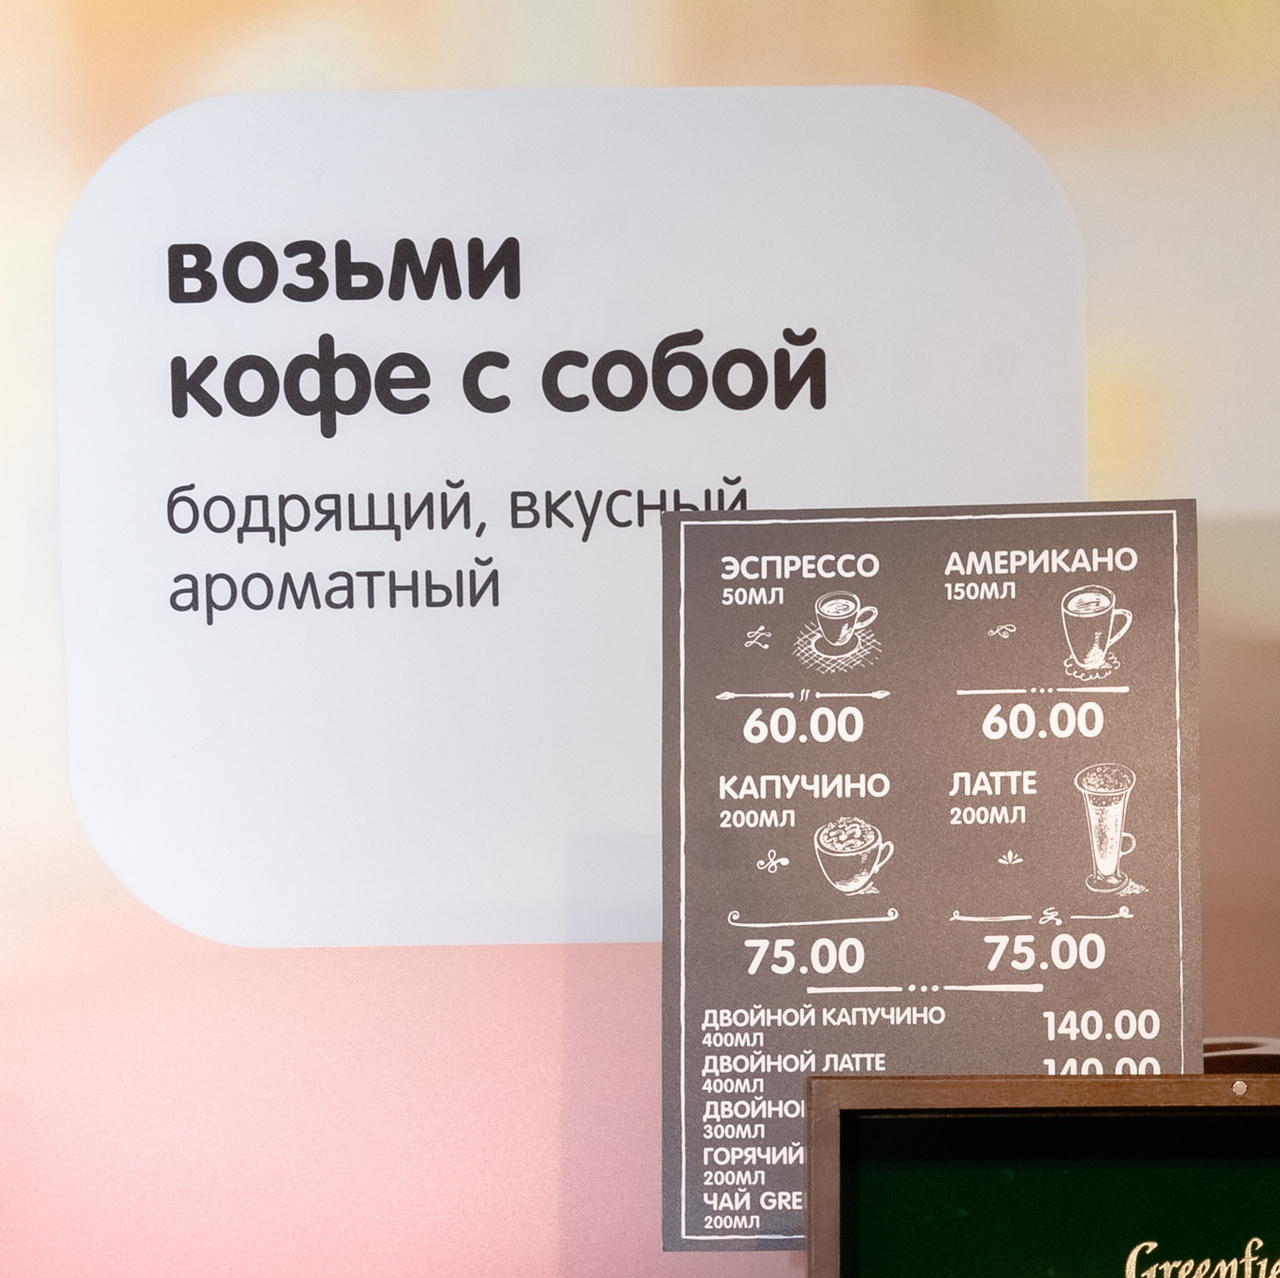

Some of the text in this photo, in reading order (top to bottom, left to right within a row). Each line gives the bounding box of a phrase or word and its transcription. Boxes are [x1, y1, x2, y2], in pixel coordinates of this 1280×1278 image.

[167, 237, 521, 304] возьми
[171, 327, 827, 439] кофе с собой
[167, 480, 487, 547] бодрящий,
[720, 553, 880, 580] ЭСПРЕССО
[944, 546, 1138, 576] АМЕРИКАНО
[169, 557, 501, 625] ароматный
[721, 587, 784, 606] 50МЛ
[944, 581, 1016, 600] 150МЛ
[742, 706, 864, 743] 60.00
[981, 702, 1103, 739] 60.00
[719, 773, 890, 800] КАПУЧИНО
[949, 771, 1037, 796] ЛАТТЕ
[719, 809, 795, 828] 200МЛ
[950, 806, 1026, 825] 200МЛ
[744, 937, 865, 975] 75.00
[983, 933, 1105, 971] 75.00
[702, 1004, 945, 1029] ДВОЙНОЙ КАПУЧИНО
[1042, 1009, 1160, 1041] 140.00
[702, 1032, 764, 1048] 400МЛ
[702, 1050, 885, 1075] ДВОЙНОЙ ЛАТТЕ
[1042, 1056, 1161, 1075] 14000
[702, 1078, 764, 1093] 400МЛ
[702, 1096, 804, 1122] ДВОЙНО
[703, 1124, 765, 1140] 300МЛ
[703, 1142, 804, 1165] ГОРЯЧИЙ
[703, 1170, 765, 1186] 200МЛ
[703, 1189, 803, 1211] ЧАЙ GRE
[704, 1215, 760, 1229] 200МЛ
